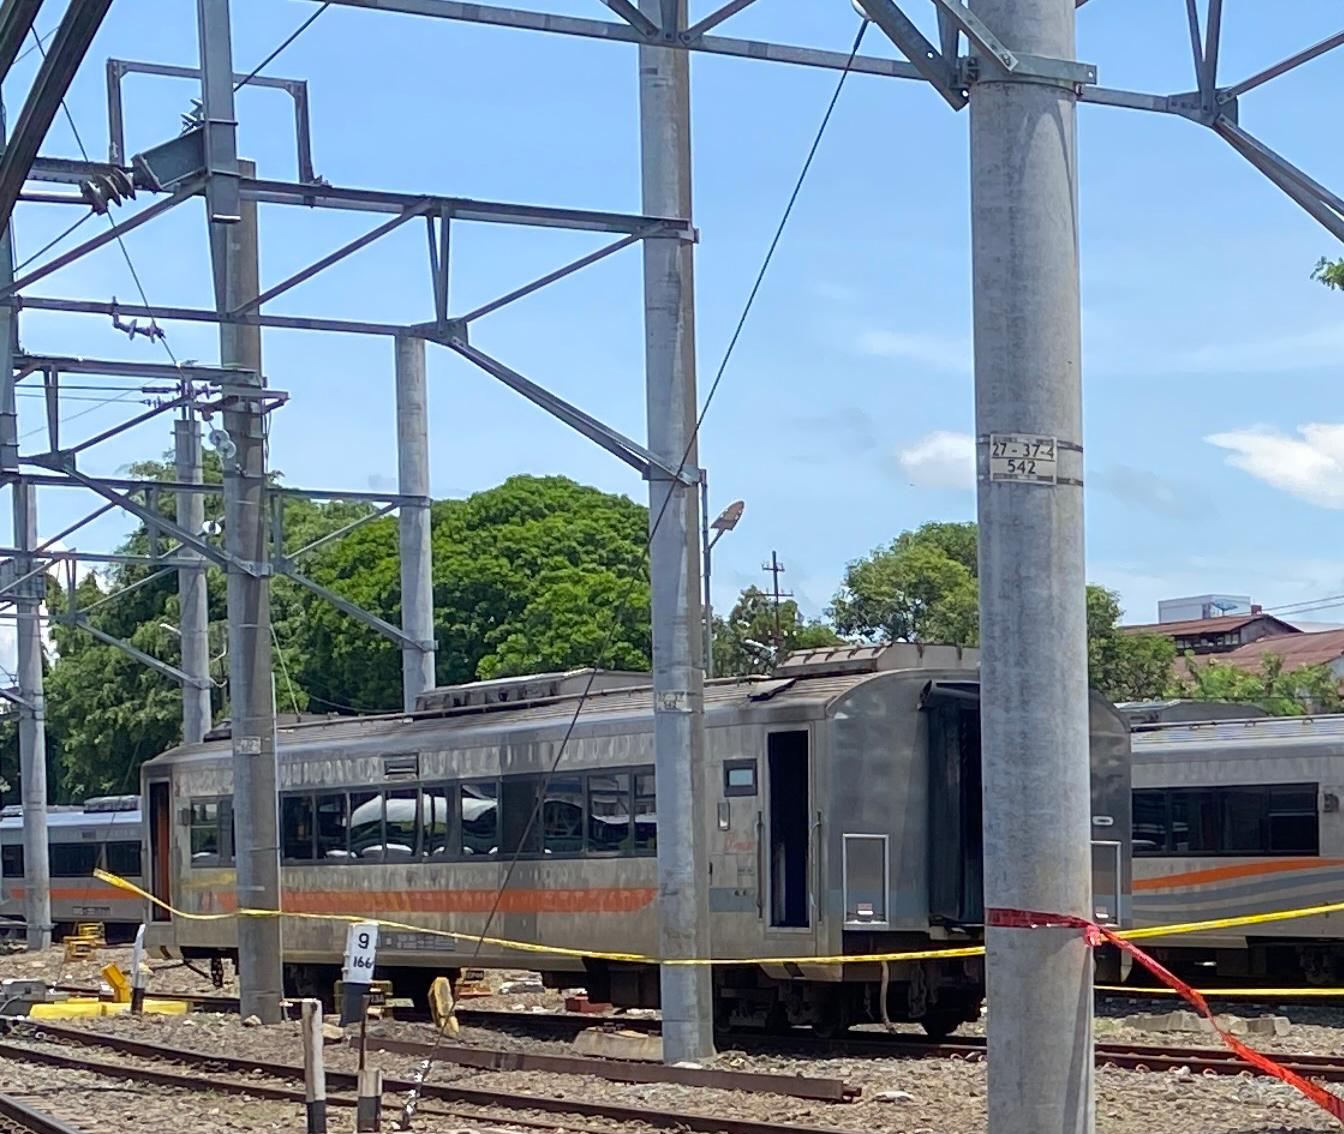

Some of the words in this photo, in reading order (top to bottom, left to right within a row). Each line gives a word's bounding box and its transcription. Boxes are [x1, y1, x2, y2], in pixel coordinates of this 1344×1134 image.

[992, 442, 1007, 457] 27
[1008, 459, 1036, 475] 542
[358, 933, 369, 949] 9
[353, 956, 373, 968] 166
